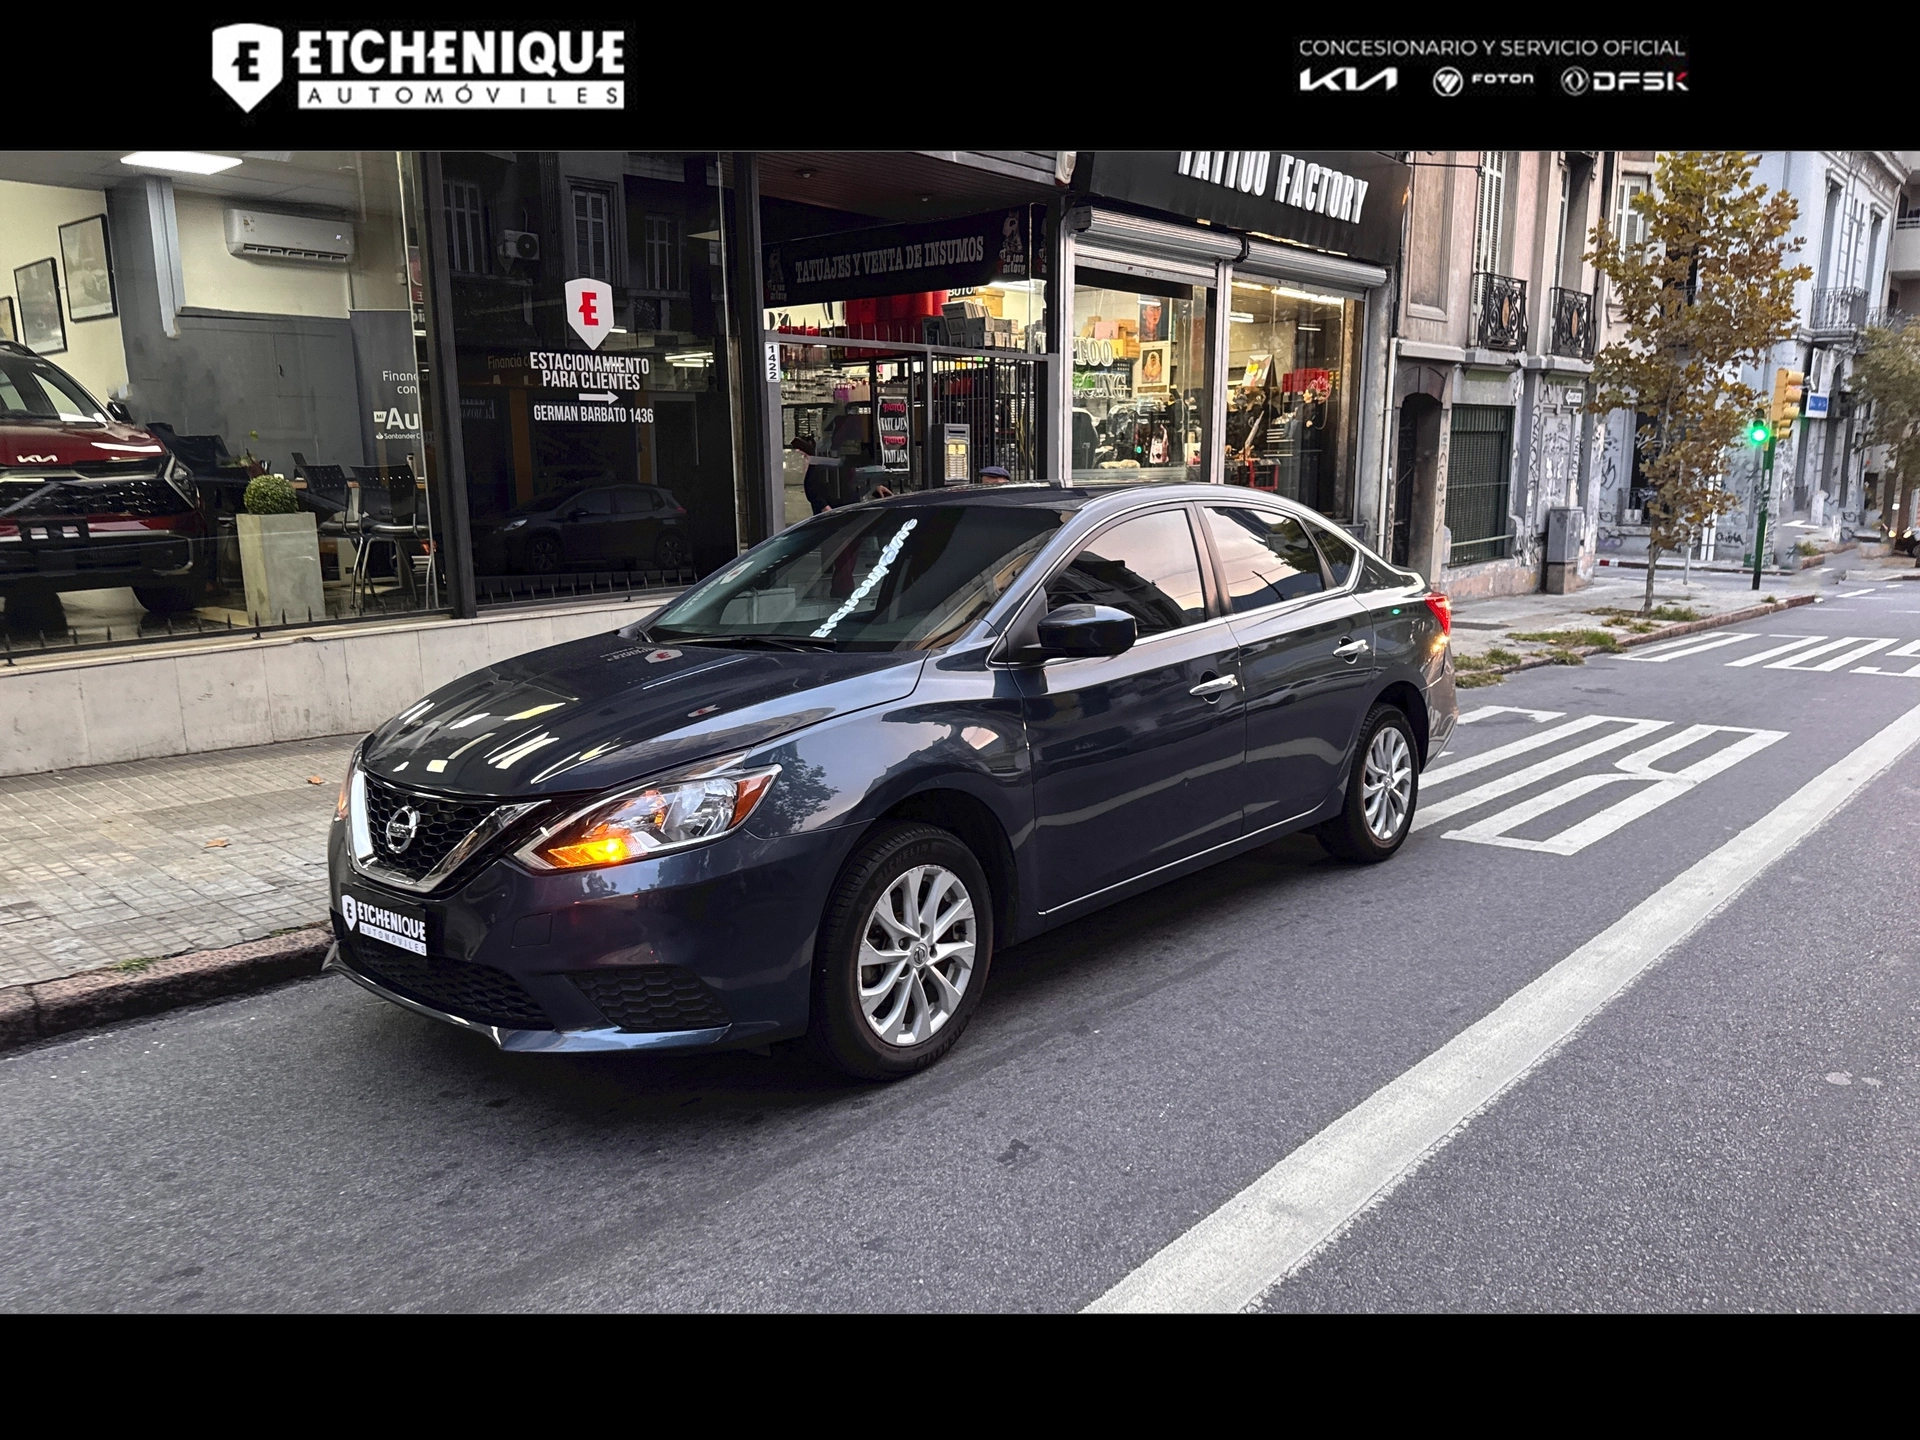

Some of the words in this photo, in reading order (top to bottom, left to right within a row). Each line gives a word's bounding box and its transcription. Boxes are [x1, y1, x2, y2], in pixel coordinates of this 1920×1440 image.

[1178, 151, 1271, 197] TATTOO
[1274, 153, 1370, 225] FACTORY
[795, 253, 852, 284] TATUAJES
[852, 252, 862, 277] Y
[862, 247, 905, 275] VENTA
[905, 244, 923, 270] DE
[924, 235, 985, 267] INSUMOS
[578, 291, 599, 326] E
[529, 351, 650, 375] ESTACIONAMIENTO
[542, 369, 579, 388] PARA
[580, 371, 641, 391] CLIENTES
[768, 345, 777, 380] 1422
[533, 404, 579, 422] GERMAN
[580, 405, 627, 423] BARBATO
[629, 407, 655, 424] 1436
[384, 432, 416, 440] Santander
[356, 901, 427, 942] ETCHENIQUE
